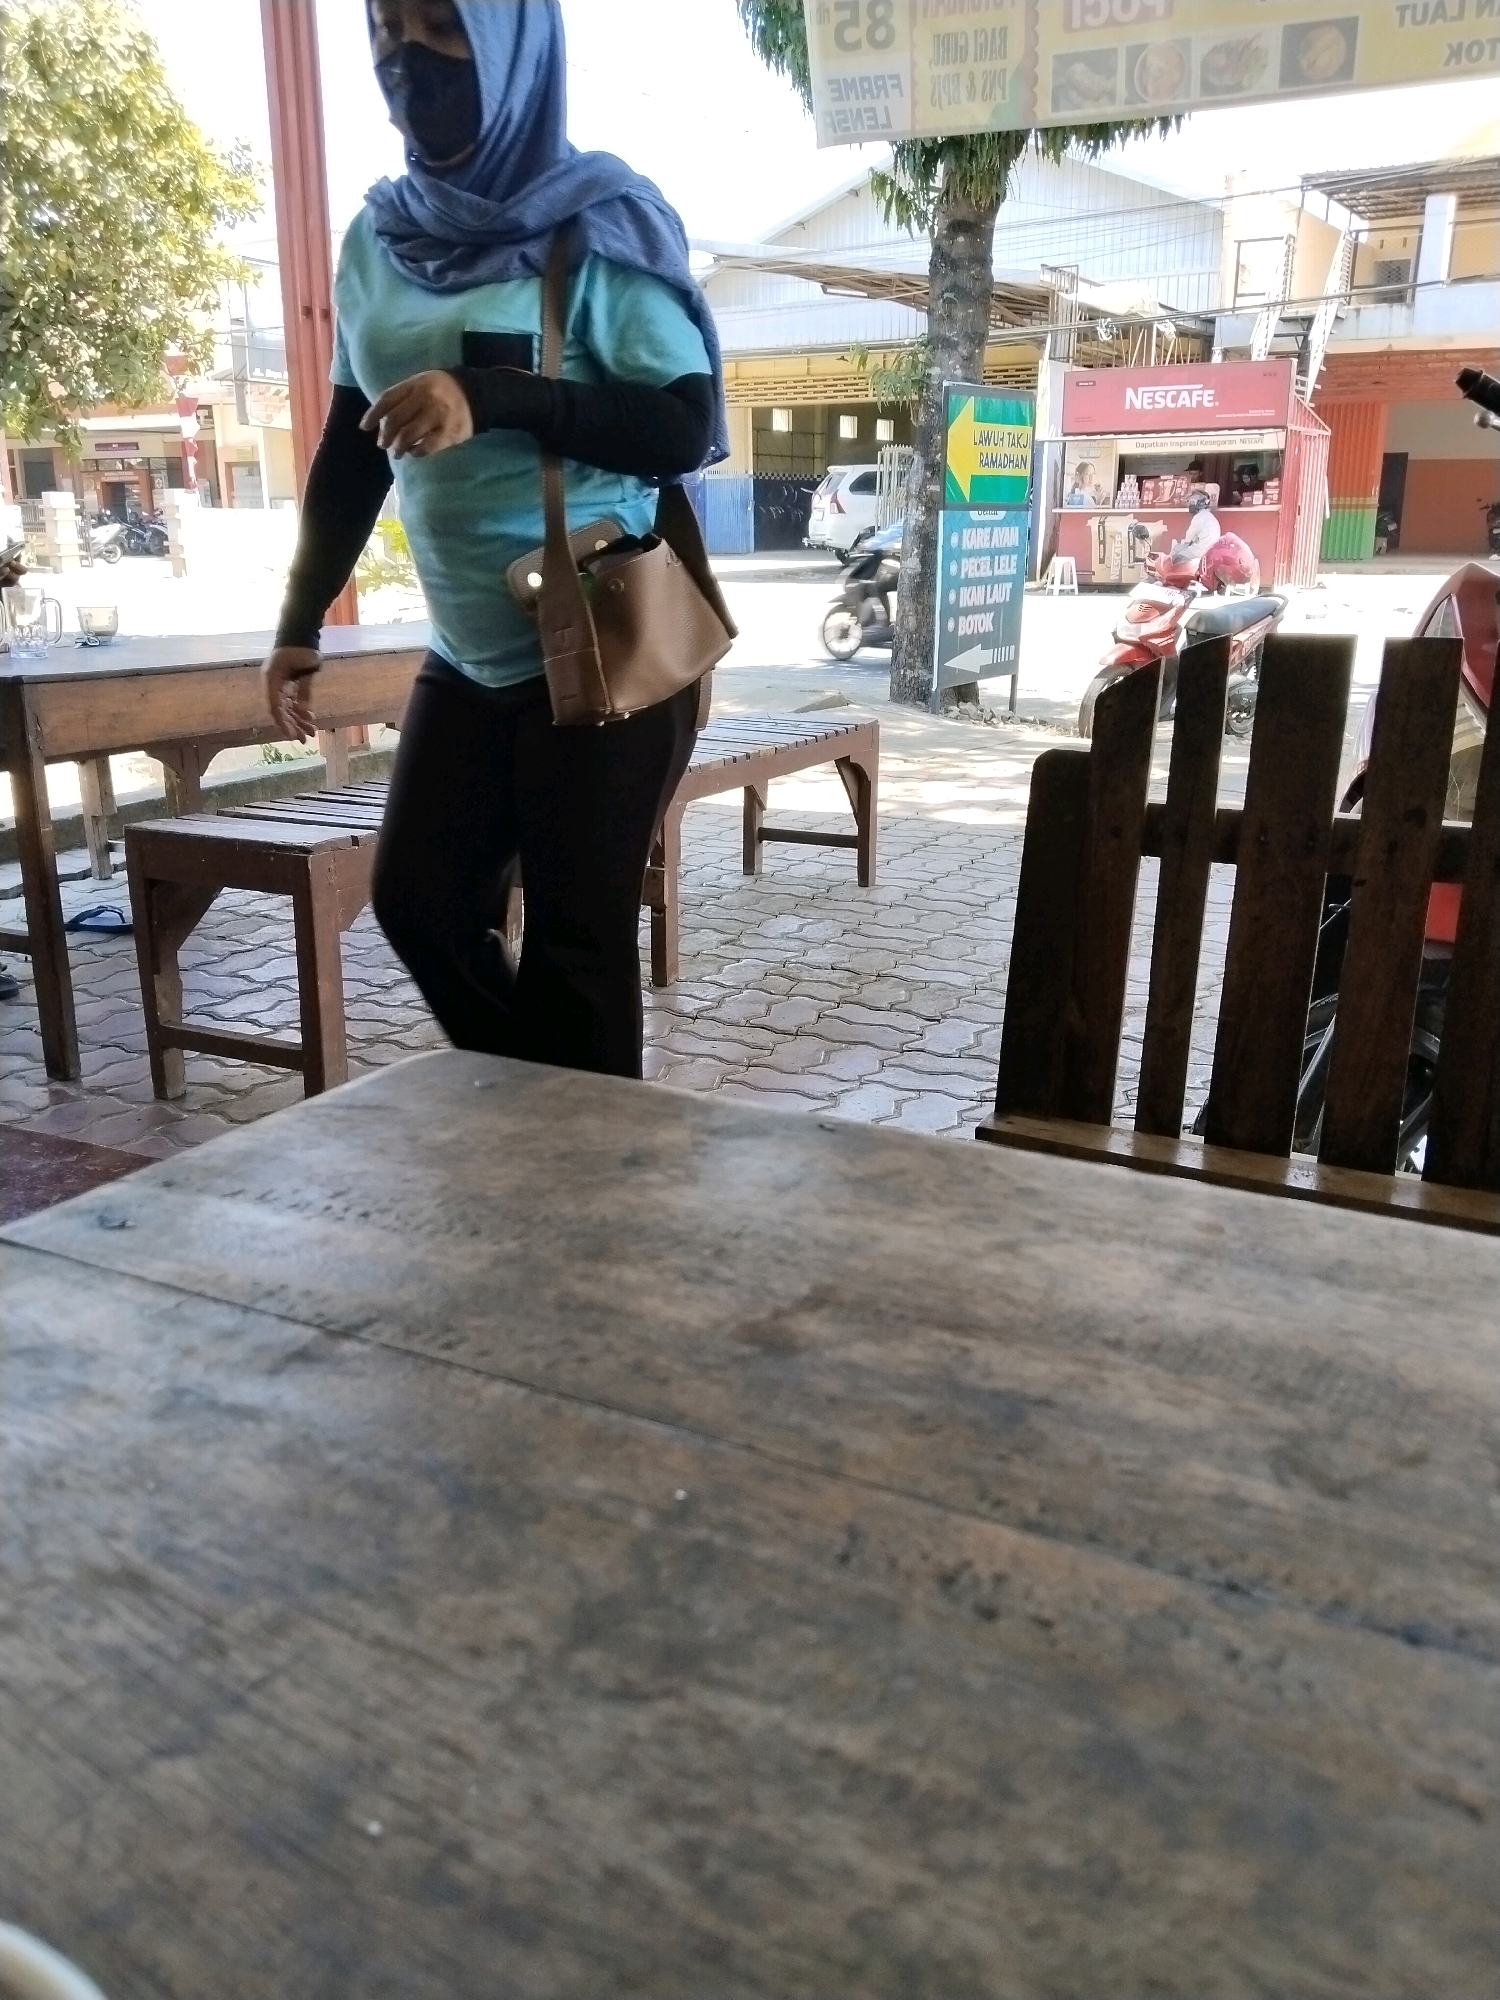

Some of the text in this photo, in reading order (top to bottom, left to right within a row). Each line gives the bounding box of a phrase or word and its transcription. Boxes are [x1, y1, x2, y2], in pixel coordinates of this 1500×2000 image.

[973, 429, 1005, 447] LAWUH
[1135, 441, 1168, 449] Dapatkan
[1169, 439, 1198, 448] Inspirasi
[1199, 438, 1236, 447] Kesegaran
[979, 451, 1027, 470] RAMADHAN
[961, 526, 1019, 550] KARE AYAM
[960, 554, 1018, 579] PECEL LELE
[959, 582, 1013, 608] IKAN LAUT
[957, 611, 995, 637] BOTOK
